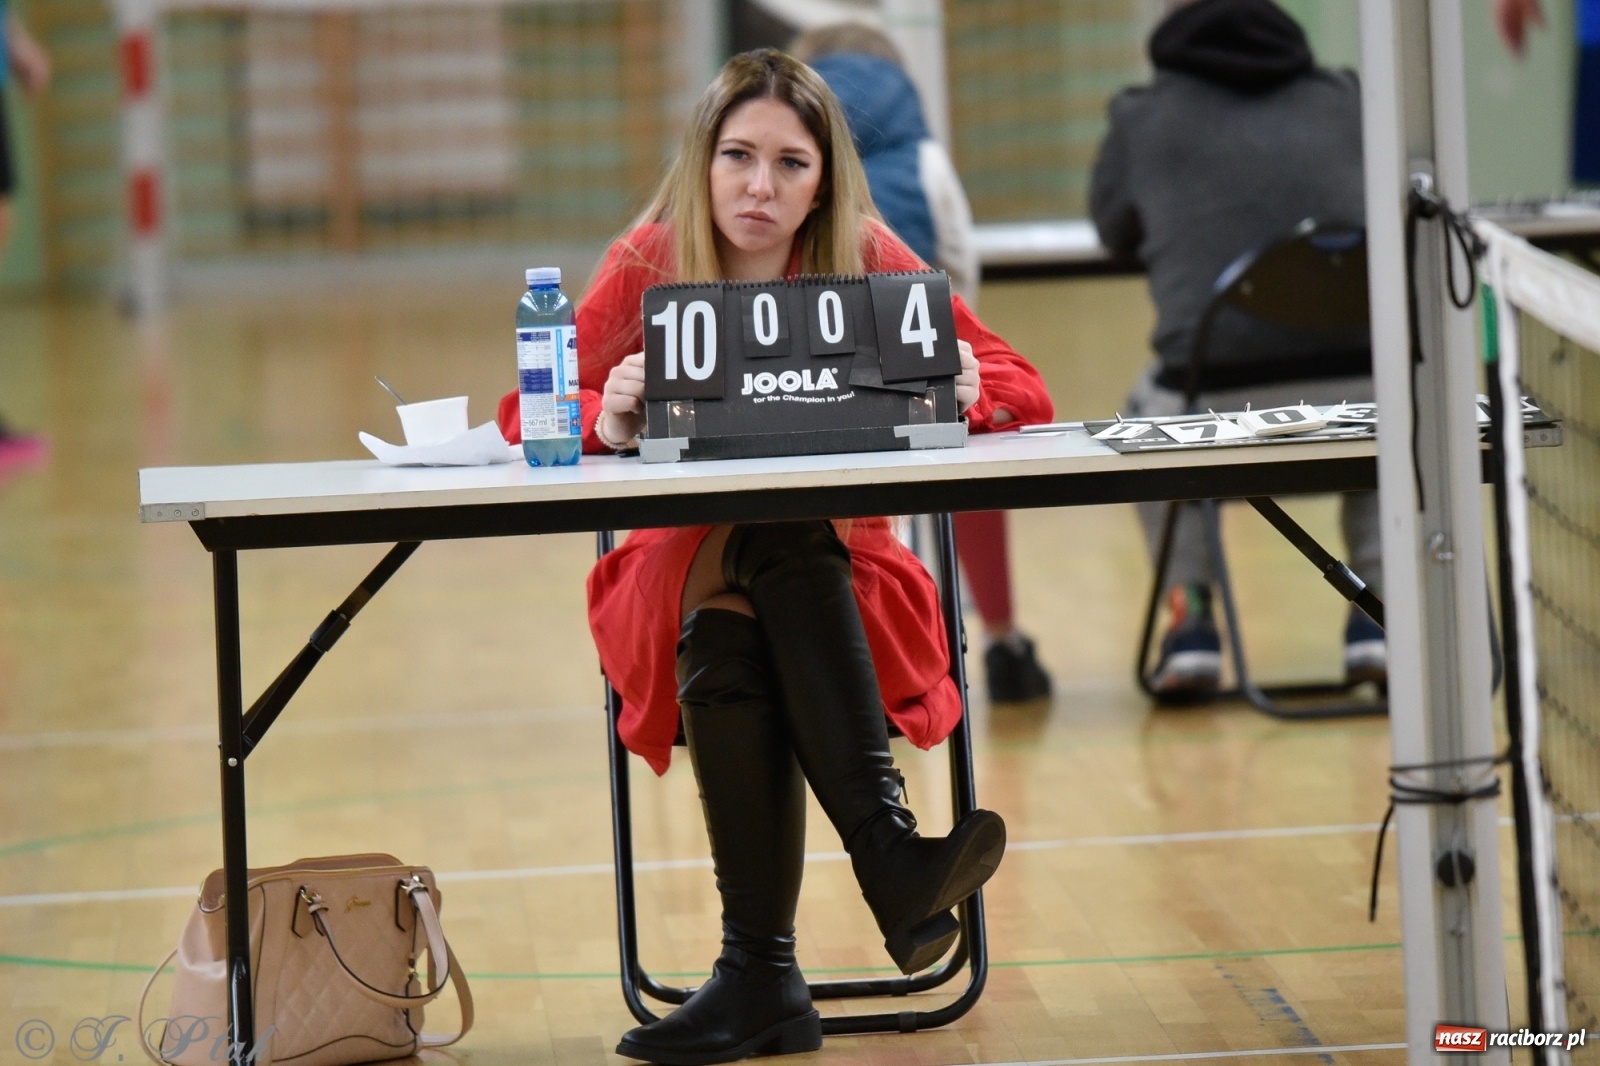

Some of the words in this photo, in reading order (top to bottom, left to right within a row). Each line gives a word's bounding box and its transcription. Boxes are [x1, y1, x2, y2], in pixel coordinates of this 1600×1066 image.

[651, 300, 718, 382] 10
[752, 292, 779, 346] 0
[817, 289, 845, 344] 0
[900, 282, 938, 358] 4
[752, 396, 766, 404] for
[767, 394, 781, 402] the
[782, 394, 826, 404] Champion
[836, 390, 856, 403] you!
